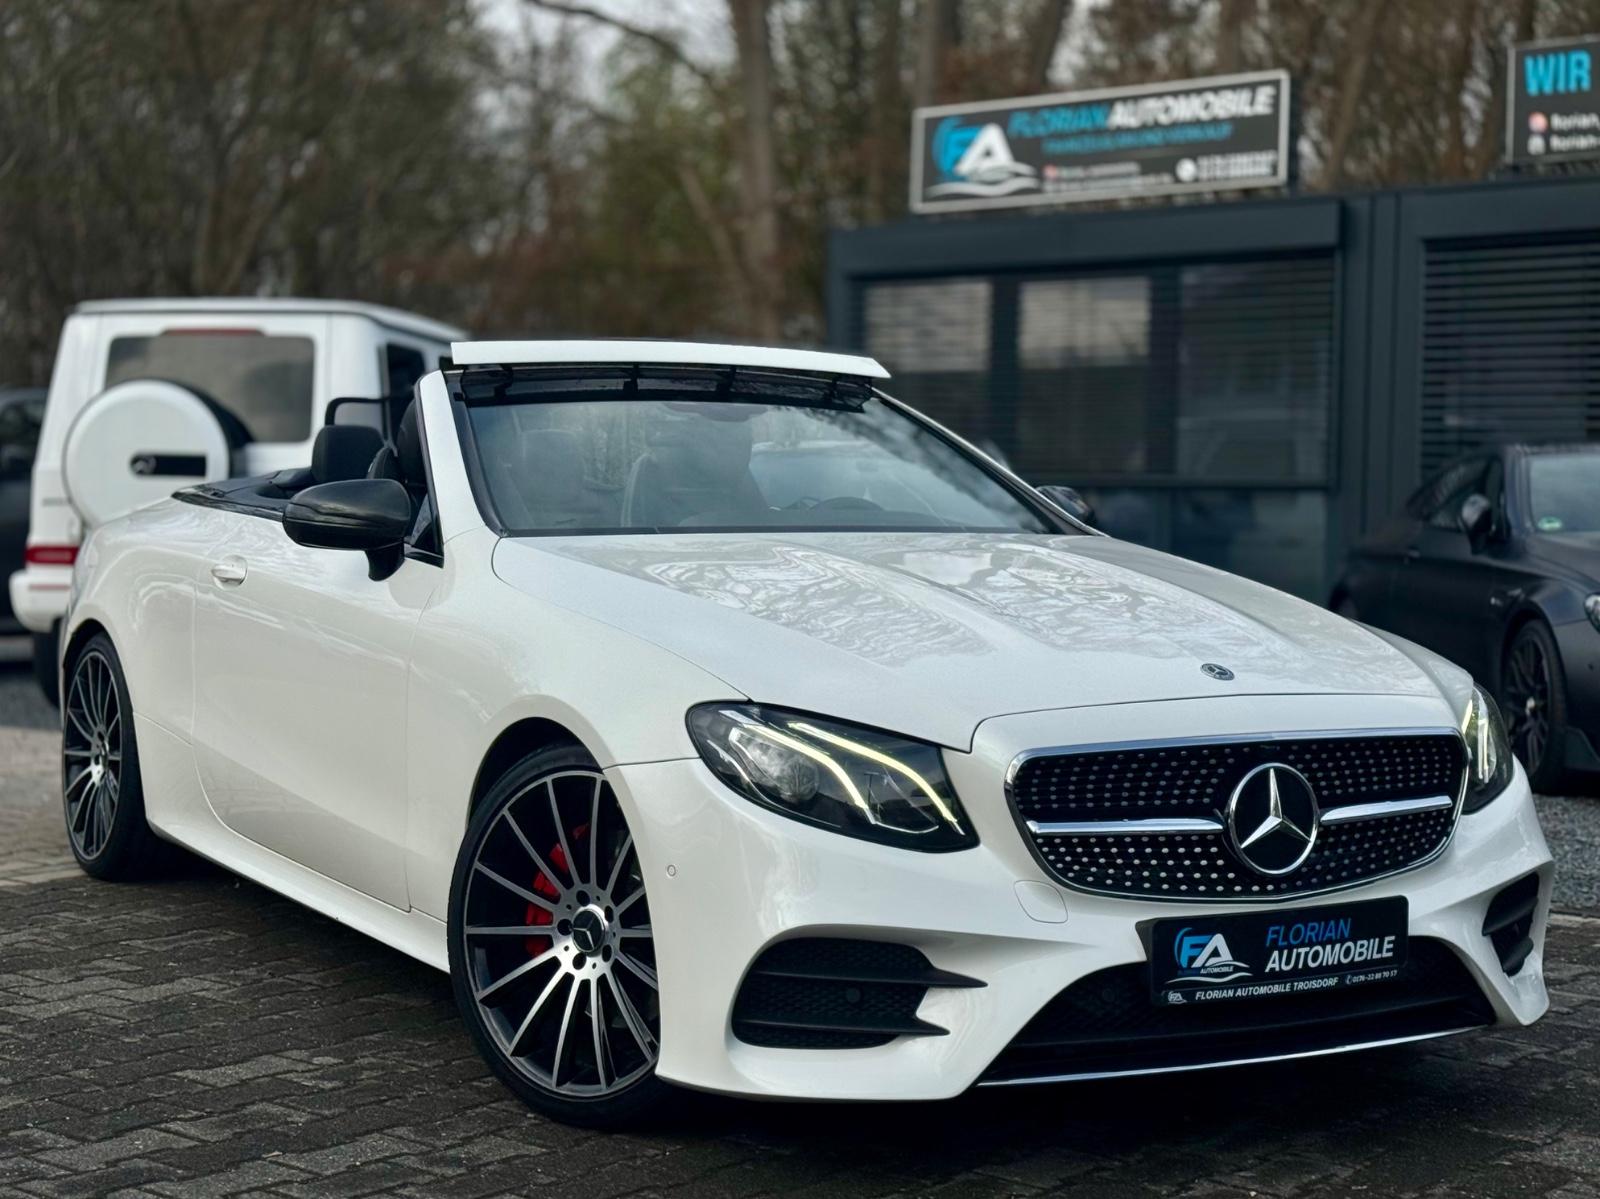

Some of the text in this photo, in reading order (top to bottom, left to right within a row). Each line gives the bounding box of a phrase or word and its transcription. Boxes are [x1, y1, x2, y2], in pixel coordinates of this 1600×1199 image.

[1525, 50, 1591, 96] WIR
[1266, 917, 1351, 947] FLORIAN
[1265, 935, 1396, 973] AUTOMOBILE
[1200, 965, 1234, 974] AUTOMOBILE
[1195, 988, 1234, 1001] FLORIAN
[1235, 982, 1291, 998] AUTOMOBILE
[1293, 977, 1339, 991] TROISDORF
